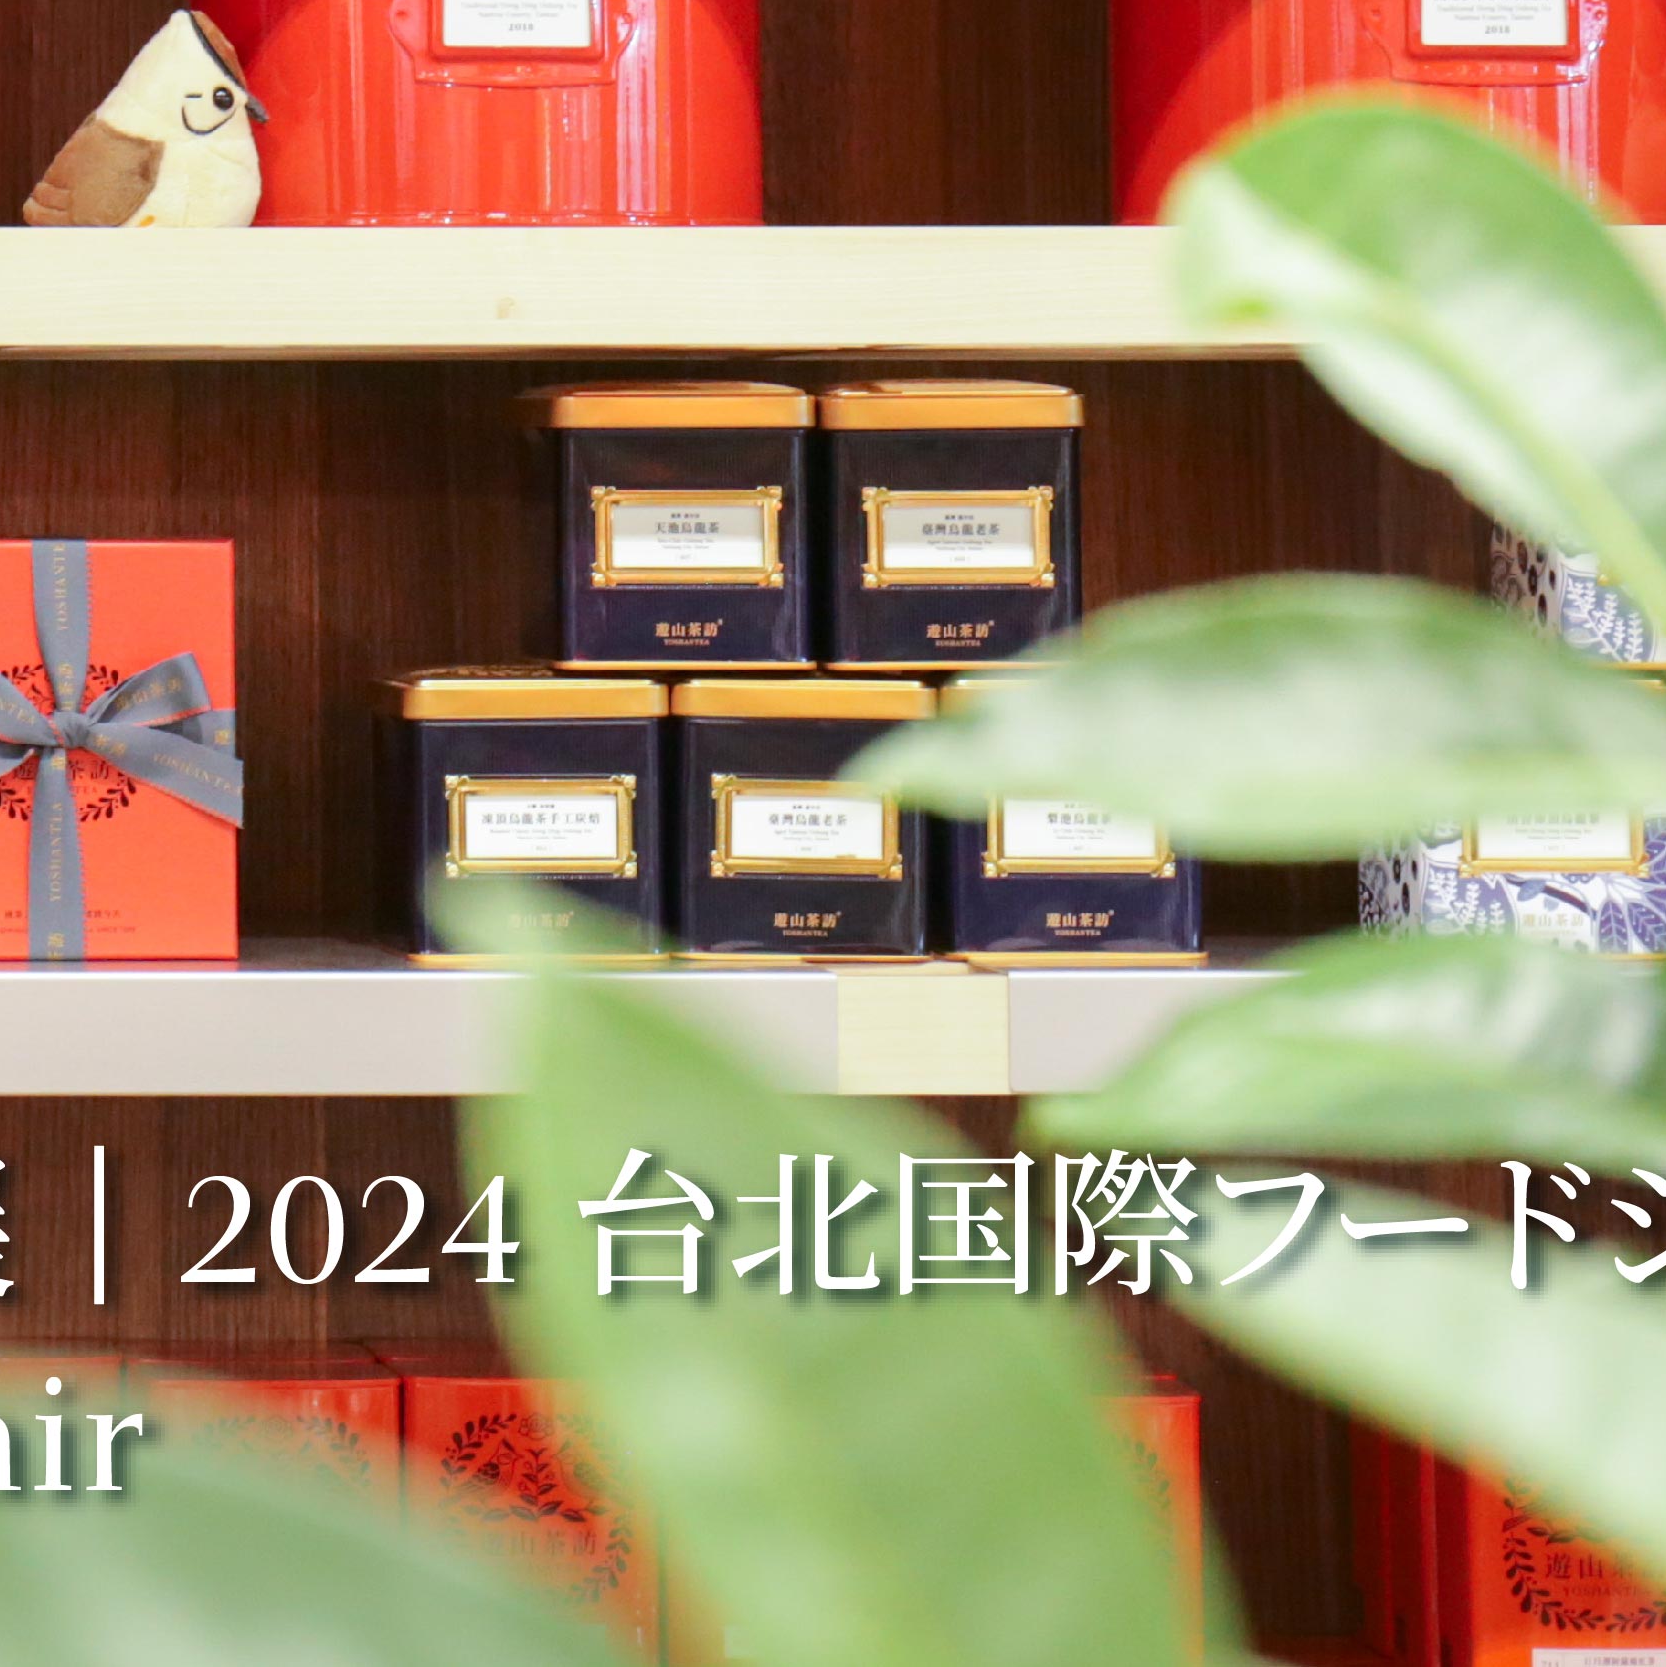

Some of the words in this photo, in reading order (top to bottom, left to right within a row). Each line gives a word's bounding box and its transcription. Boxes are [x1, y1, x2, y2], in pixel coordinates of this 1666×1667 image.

[654, 622, 718, 637] 遊山茶訪
[926, 623, 989, 638] 遊山茶訪
[773, 912, 837, 927] 遊山茶訪
[1045, 913, 1109, 927] 遊山茶訪
